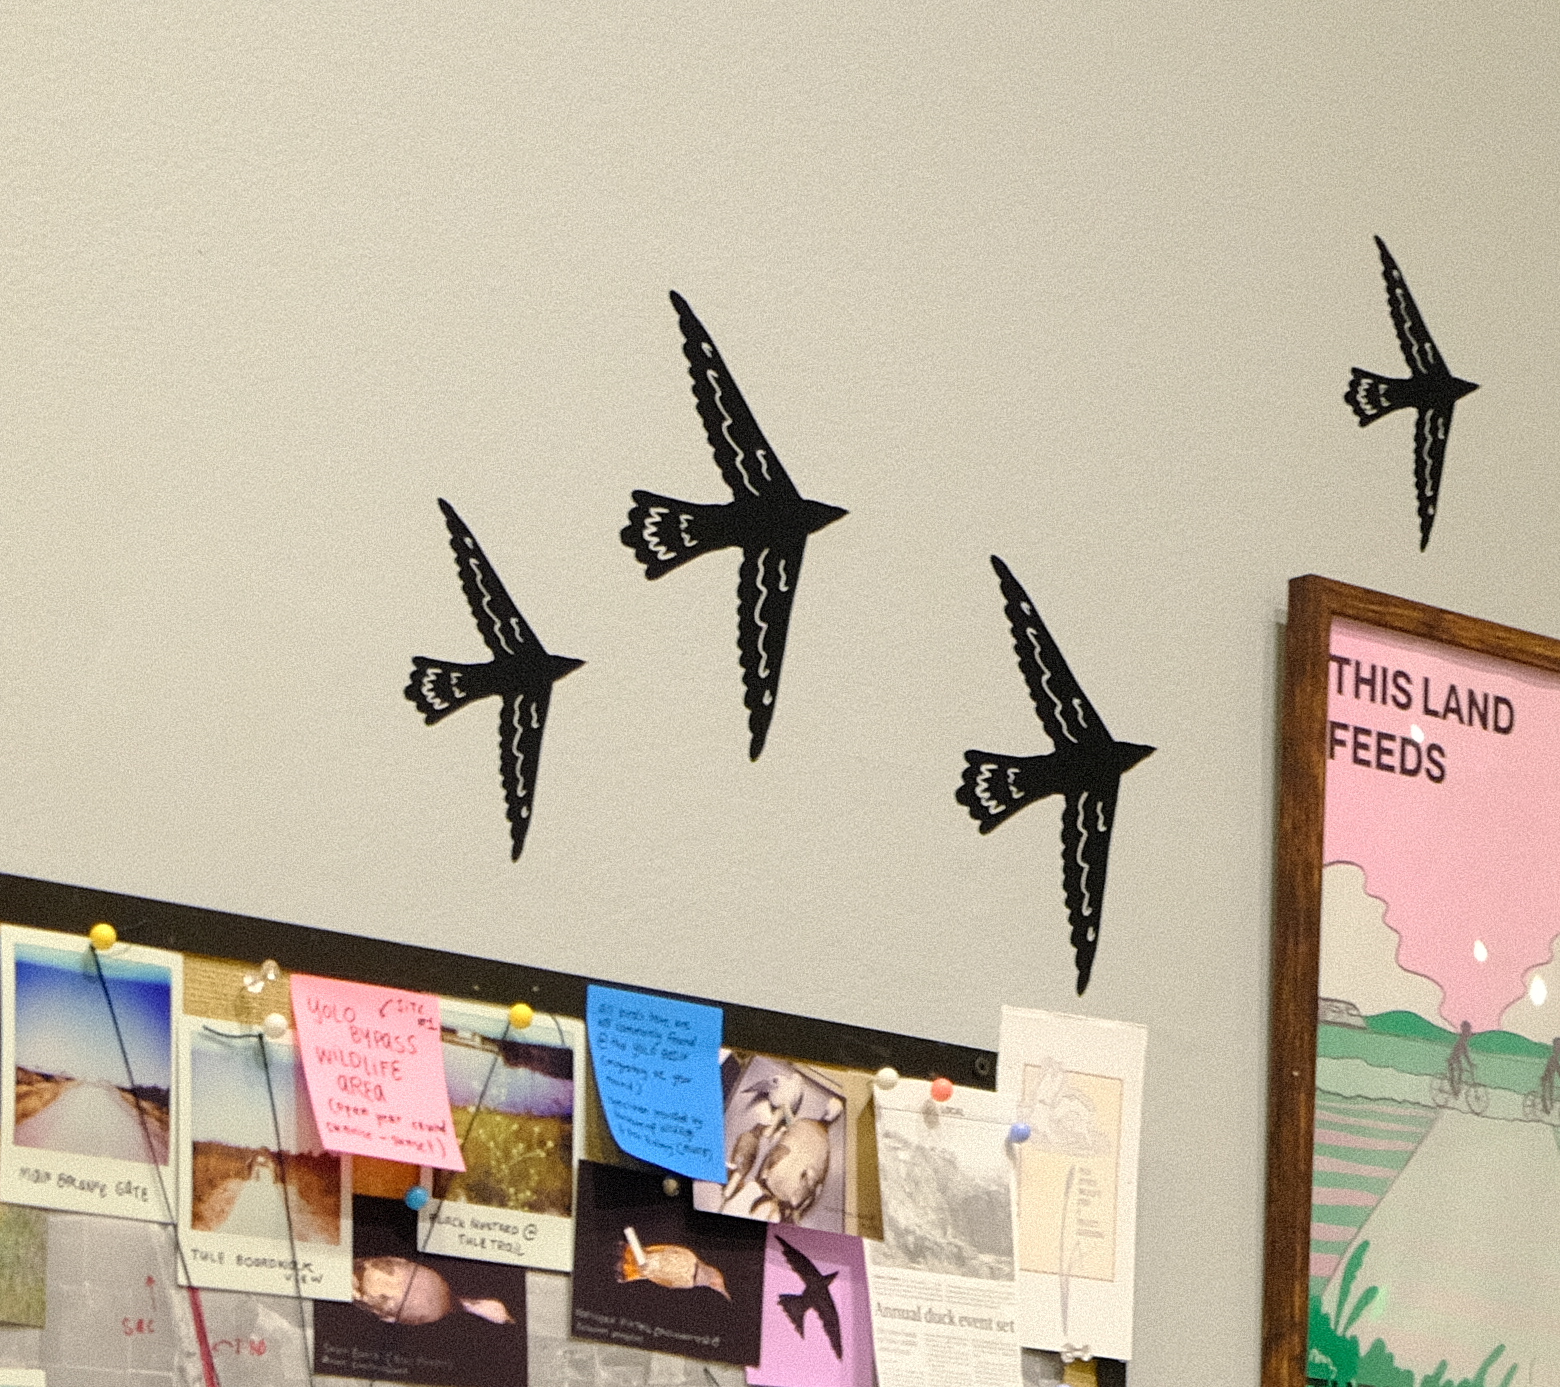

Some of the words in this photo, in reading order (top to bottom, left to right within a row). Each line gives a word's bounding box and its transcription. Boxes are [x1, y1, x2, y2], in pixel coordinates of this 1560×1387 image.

[1329, 652, 1413, 711] THIS
[1423, 676, 1515, 735] LAND
[1329, 720, 1446, 784] FEEDS
[349, 1025, 418, 1054] BYPASS
[315, 1046, 403, 1081] WILDLIFE
[875, 1302, 922, 1323] Annual
[923, 1307, 955, 1327] duck
[958, 1313, 994, 1332] event
[996, 1318, 1015, 1333] set
